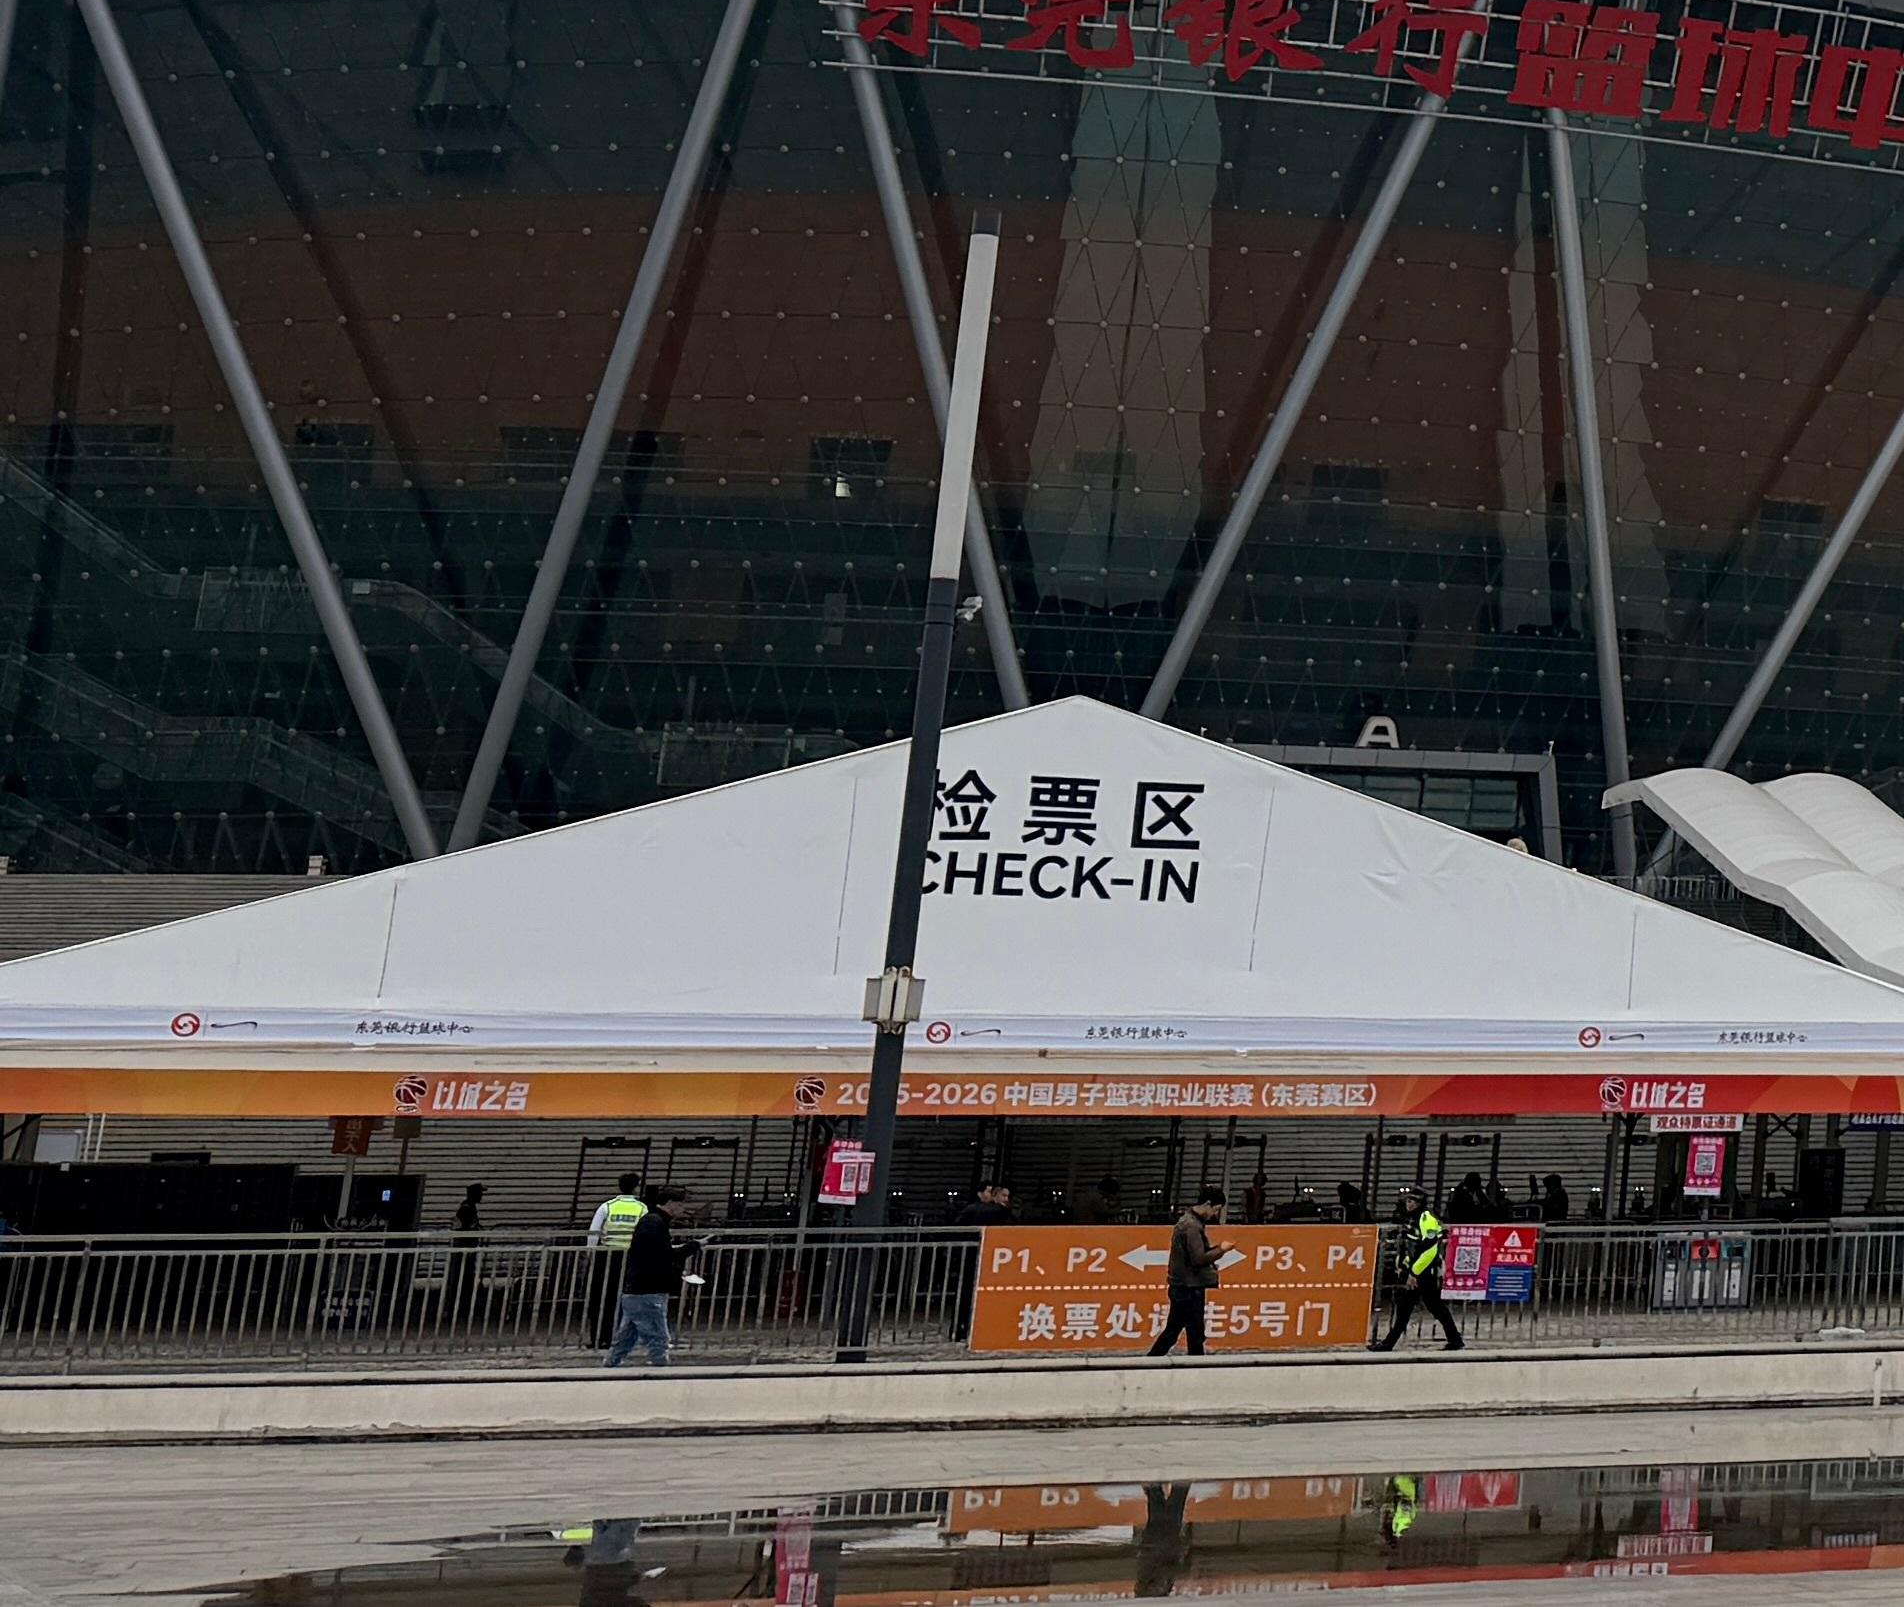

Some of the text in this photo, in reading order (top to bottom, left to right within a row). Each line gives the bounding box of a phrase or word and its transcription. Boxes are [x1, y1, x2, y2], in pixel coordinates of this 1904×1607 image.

[1357, 716, 1399, 748] A
[930, 769, 1205, 850] 检票区
[354, 1020, 474, 1036] 东莞银行篮球中心
[432, 1080, 530, 1111] 以城之名
[836, 1082, 997, 1105] 205-2026
[1630, 1081, 1706, 1109] 以城之名
